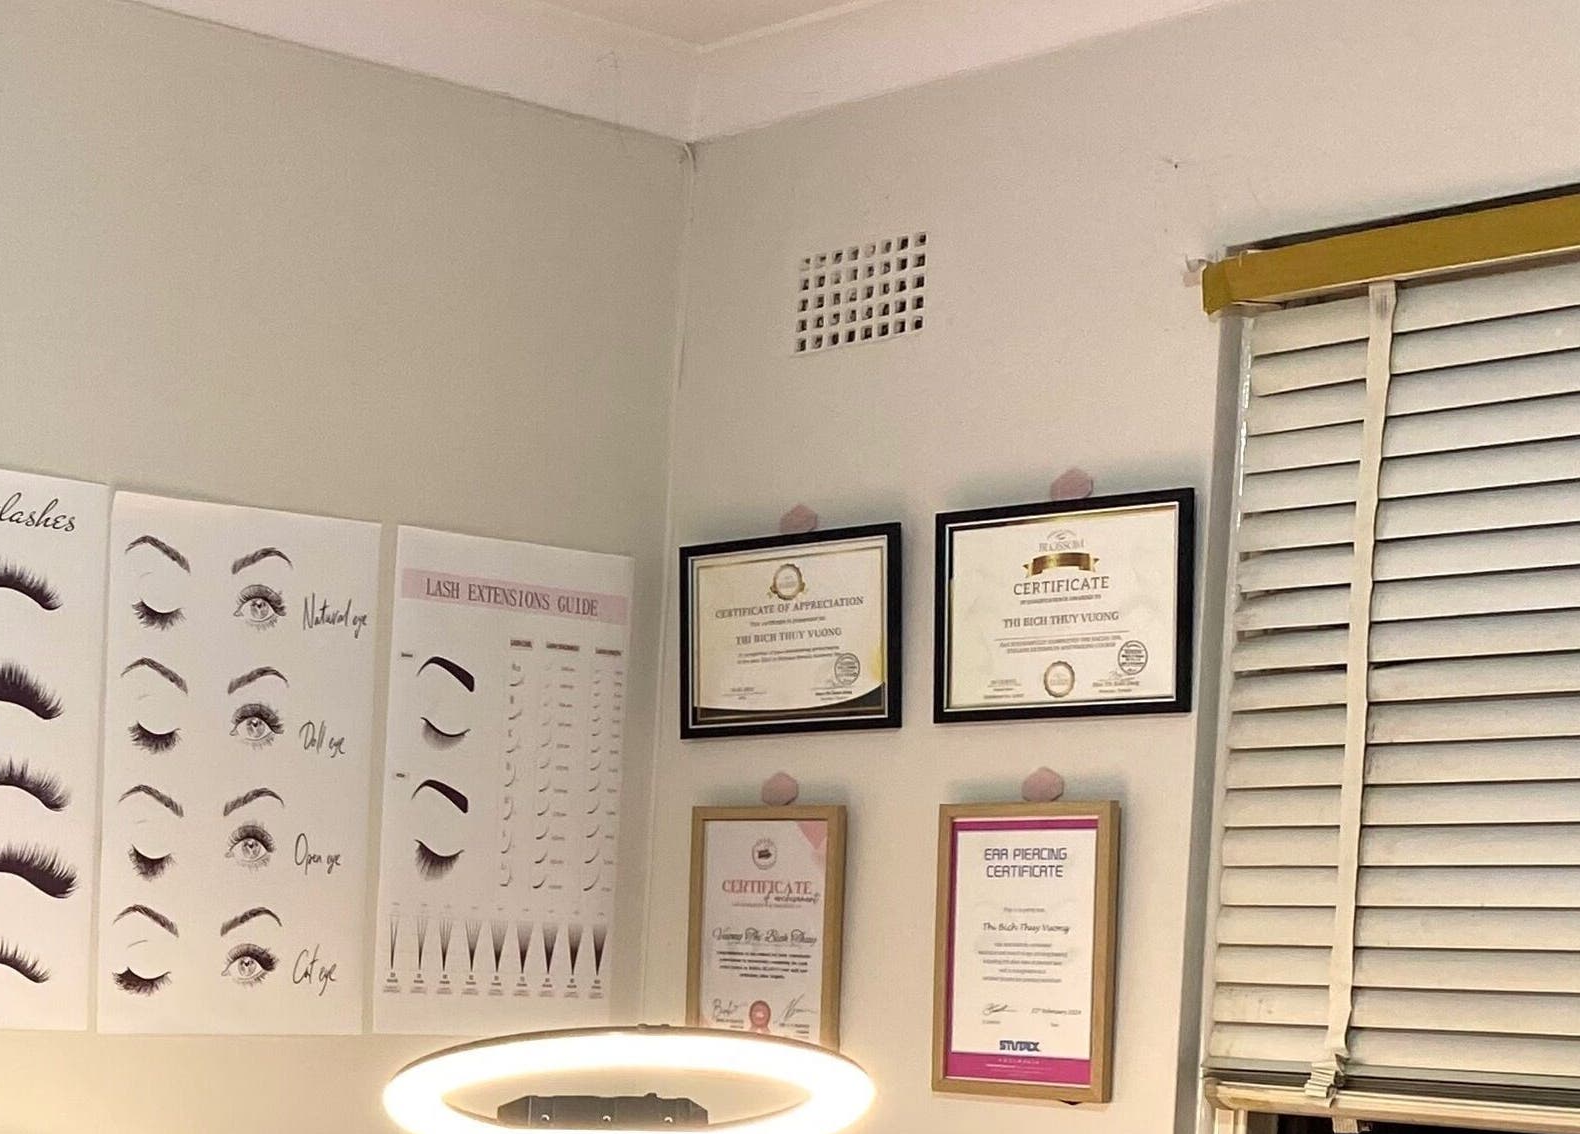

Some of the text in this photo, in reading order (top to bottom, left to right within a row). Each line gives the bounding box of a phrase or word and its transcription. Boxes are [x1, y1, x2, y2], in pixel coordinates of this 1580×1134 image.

[426, 577, 599, 618] LASH EXTENSIONS GUIDE
[1013, 576, 1110, 597] CERTIFICATE
[303, 593, 369, 638] Natural eye
[715, 596, 865, 620] CERTIFICATE OF APPRECIATION
[1002, 617, 1021, 629] THI
[1080, 611, 1119, 623] VUONG
[808, 627, 842, 639] VUONG
[299, 720, 346, 759] Doll eye
[295, 832, 342, 875] Open eye
[983, 847, 1067, 861] EAR PIERCING
[986, 864, 1064, 879] CERTIFICATE
[722, 879, 812, 895] CERTIFICATE
[292, 943, 337, 997] Cat eye
